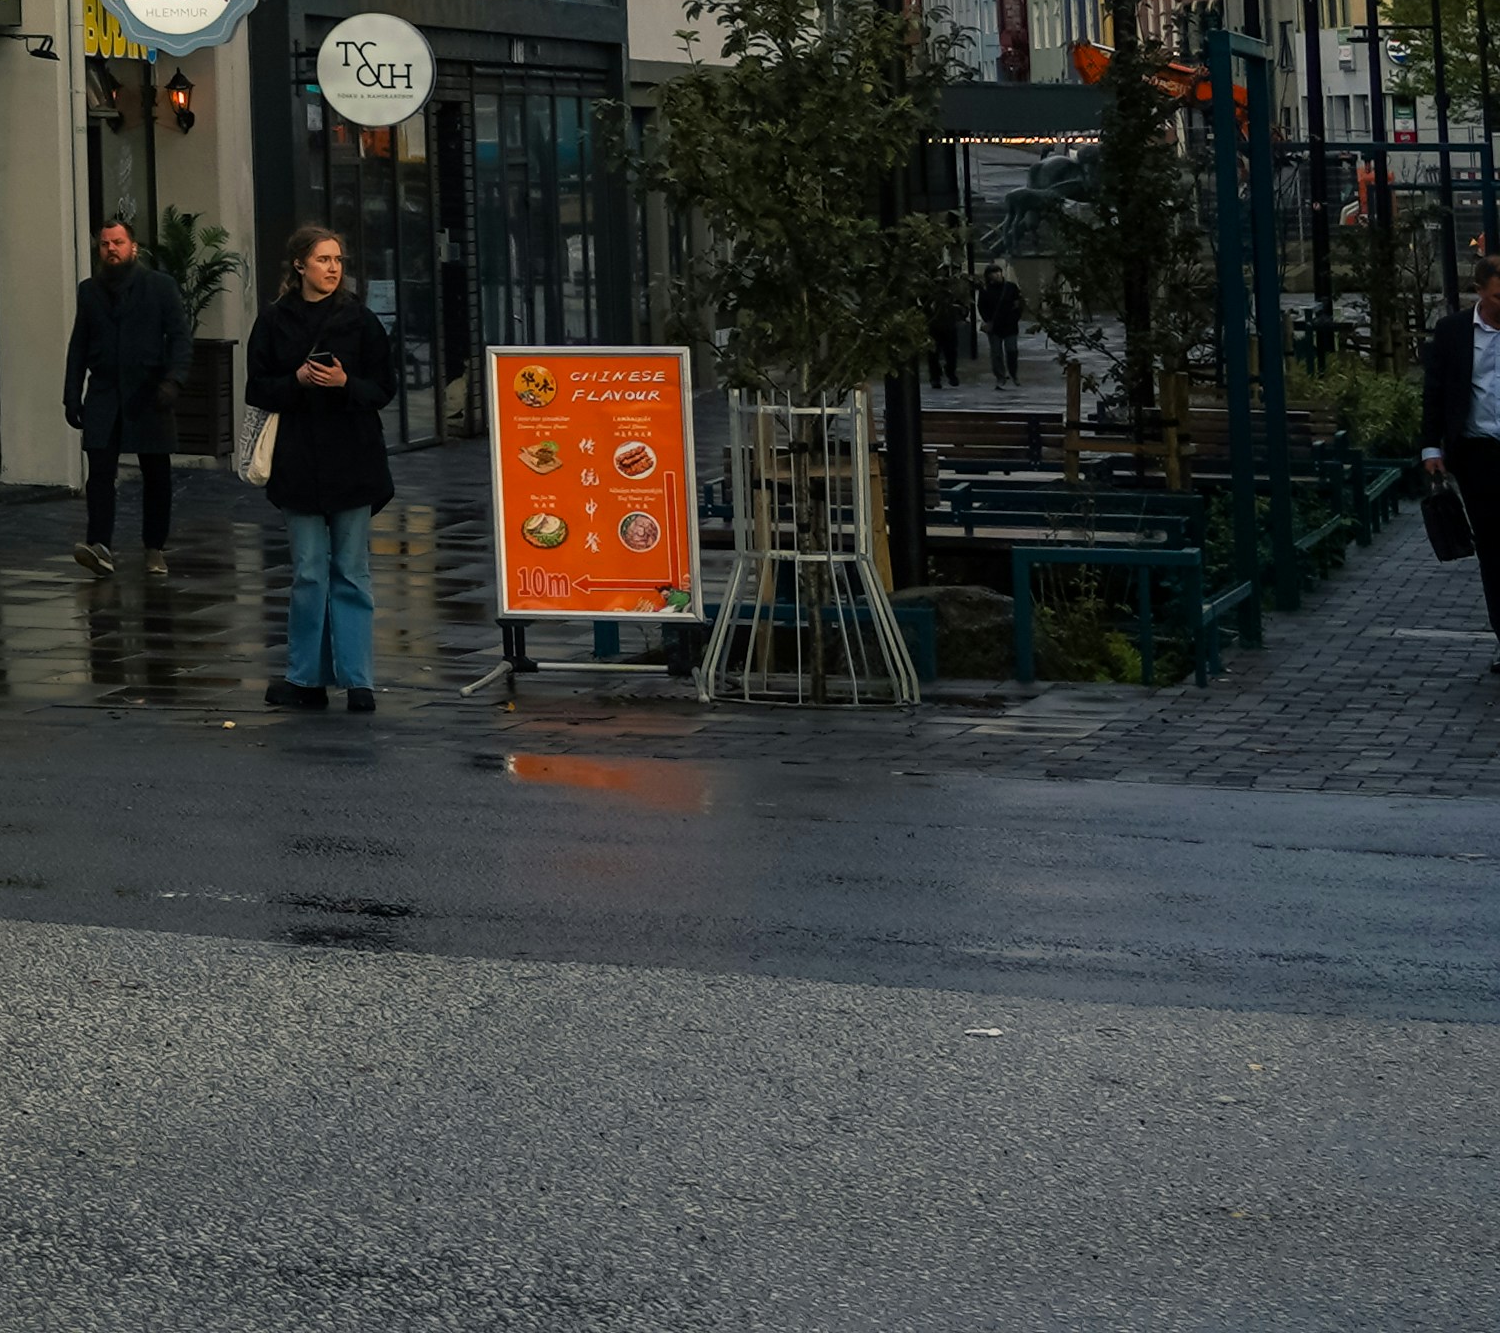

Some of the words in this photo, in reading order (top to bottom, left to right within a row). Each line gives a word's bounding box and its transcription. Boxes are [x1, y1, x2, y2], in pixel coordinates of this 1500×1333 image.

[145, 7, 208, 18] HLEMMUR
[569, 370, 666, 382] CHINESE
[571, 389, 661, 402] FLAVOUR
[517, 565, 571, 598] 10m
